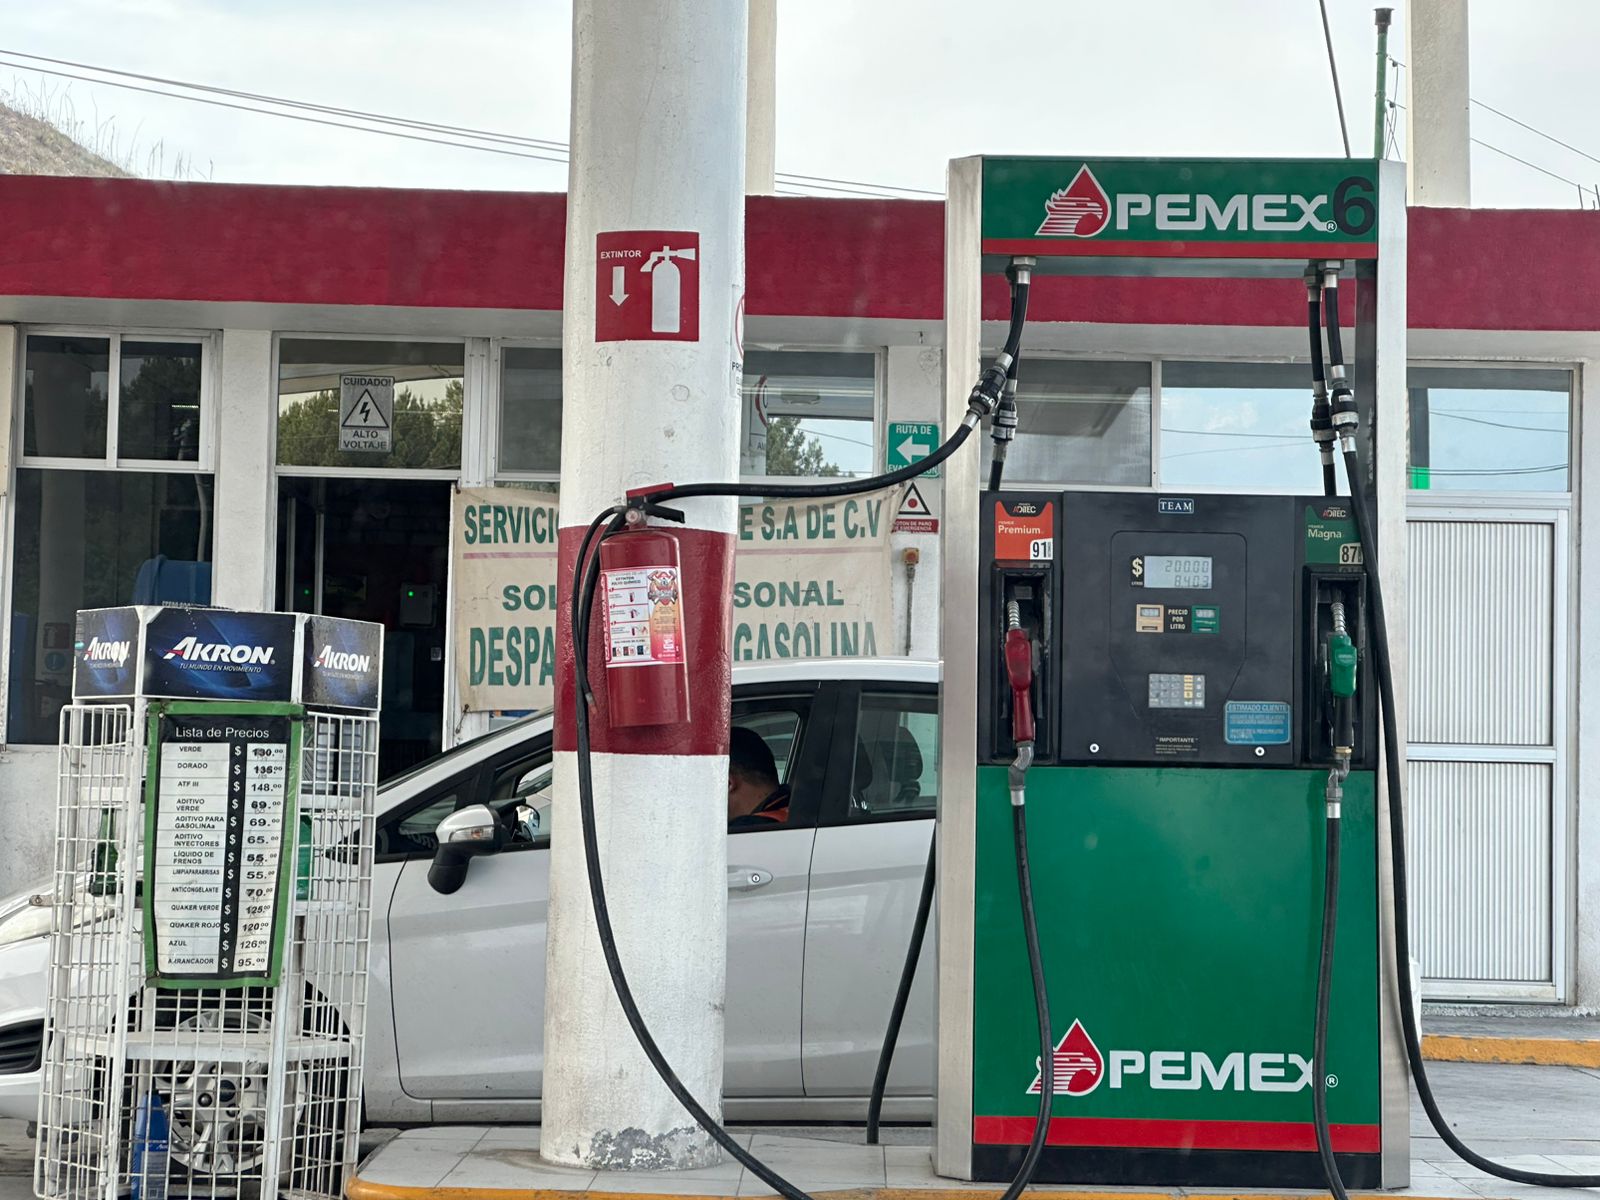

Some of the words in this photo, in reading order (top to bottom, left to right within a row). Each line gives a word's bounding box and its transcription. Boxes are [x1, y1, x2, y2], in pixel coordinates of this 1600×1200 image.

[1333, 176, 1376, 236] 6
[1116, 193, 1331, 232] PEMEX
[600, 250, 642, 260] EXTINTOR
[343, 377, 392, 386] CUIDADO!
[352, 430, 378, 438] ALTO
[896, 425, 918, 434] RUTA
[920, 426, 932, 434] DE
[344, 440, 387, 448] VOLTAJE
[1160, 501, 1192, 510] TEAM
[464, 505, 559, 544] SERVICI
[740, 507, 754, 541] E
[761, 505, 799, 541] S.A
[806, 503, 836, 540] DE
[843, 500, 882, 539] C.V
[998, 524, 1041, 534] Premium
[1308, 528, 1342, 540] Magna
[1032, 541, 1047, 558] 91
[1342, 546, 1358, 562] 87
[1132, 558, 1143, 578] $
[733, 580, 844, 608] SONAL
[84, 636, 130, 661] AKRON
[163, 637, 274, 665] AKRON
[314, 645, 371, 672] AKRON
[470, 626, 555, 686] DESPA
[176, 726, 203, 738] Lista
[206, 726, 221, 738] de
[225, 726, 269, 738] Precios
[234, 746, 241, 756] $
[234, 764, 241, 775] $
[233, 781, 240, 792] $
[251, 783, 282, 792] 148.00
[232, 799, 239, 809] $
[230, 816, 237, 827] $
[249, 818, 280, 827] 69.00
[229, 834, 236, 845] $
[228, 852, 235, 862] $
[228, 869, 234, 879] $
[246, 870, 275, 879] 55.00
[225, 888, 232, 898] $
[224, 904, 231, 915] $
[224, 923, 230, 933] $
[222, 940, 229, 951] $
[222, 958, 228, 969] $
[238, 958, 265, 967] 95.00
[1109, 1050, 1314, 1092] PEMEX
